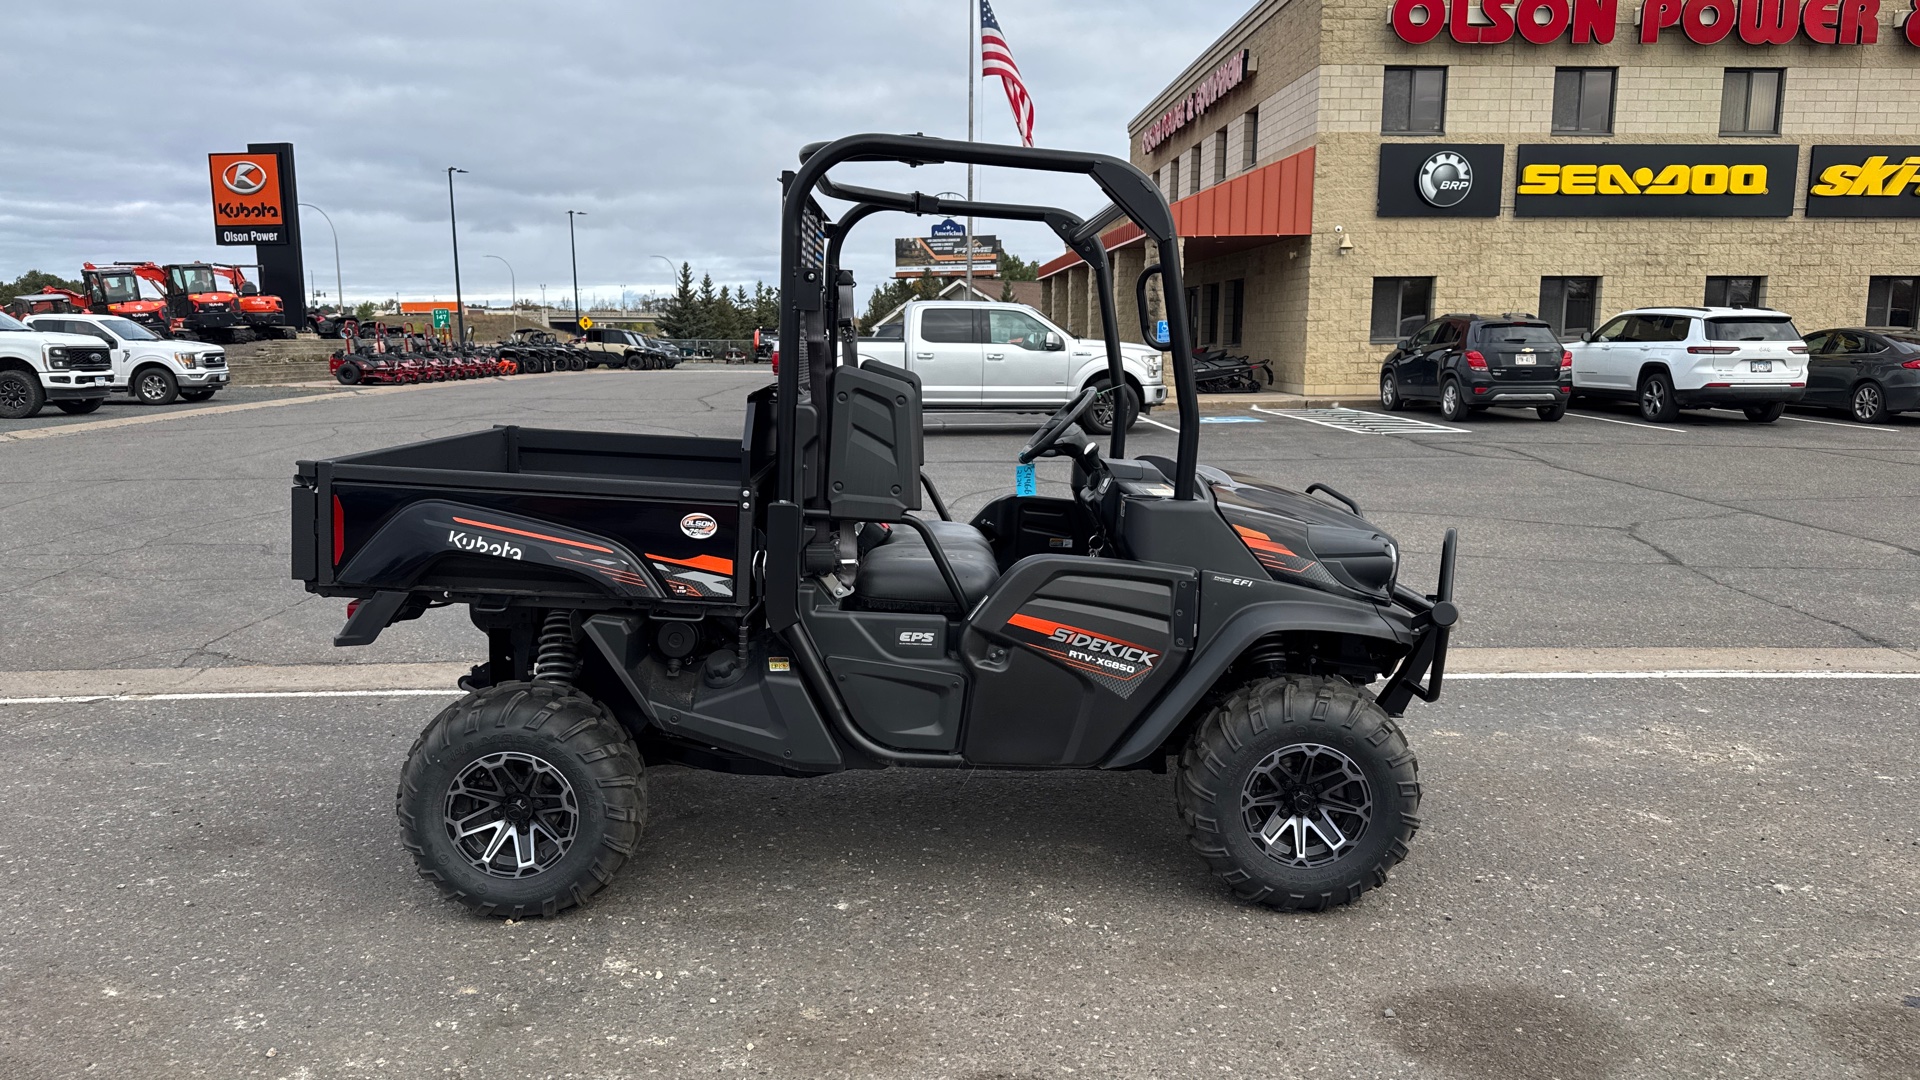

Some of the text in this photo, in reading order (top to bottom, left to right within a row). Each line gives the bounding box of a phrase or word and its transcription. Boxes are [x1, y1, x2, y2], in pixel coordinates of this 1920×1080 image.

[1392, 0, 1617, 44] OLSON
[1640, 0, 1880, 44] POWER
[1440, 180, 1469, 190] BRP
[218, 202, 279, 218] Kubota
[224, 230, 278, 242] Olson Power
[685, 519, 714, 527] OLSON
[449, 530, 522, 560] Kubota
[1232, 578, 1254, 587] EFI
[899, 631, 935, 643] EPS
[1047, 627, 1160, 667] SIDEKICK
[1068, 650, 1135, 674] RTV-XG850
